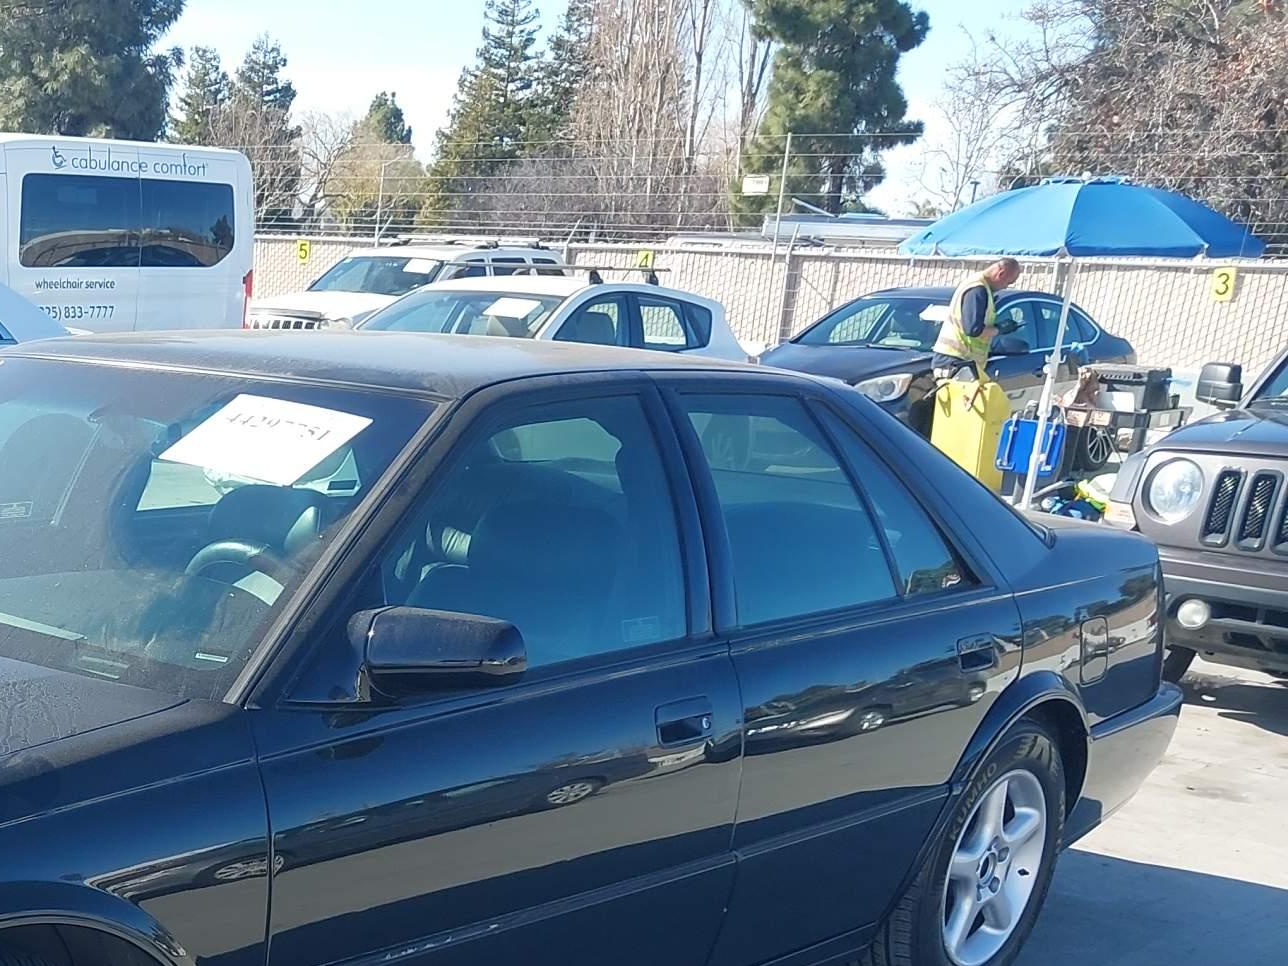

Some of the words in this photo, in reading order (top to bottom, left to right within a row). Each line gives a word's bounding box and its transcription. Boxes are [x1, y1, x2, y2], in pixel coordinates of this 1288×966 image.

[71, 145, 148, 173] cabulance
[153, 152, 207, 177] comfort
[299, 243, 308, 260] 5
[34, 277, 83, 289] wheelchair
[84, 277, 116, 289] service
[1215, 272, 1230, 296] 3
[63, 305, 114, 319] 833-7777
